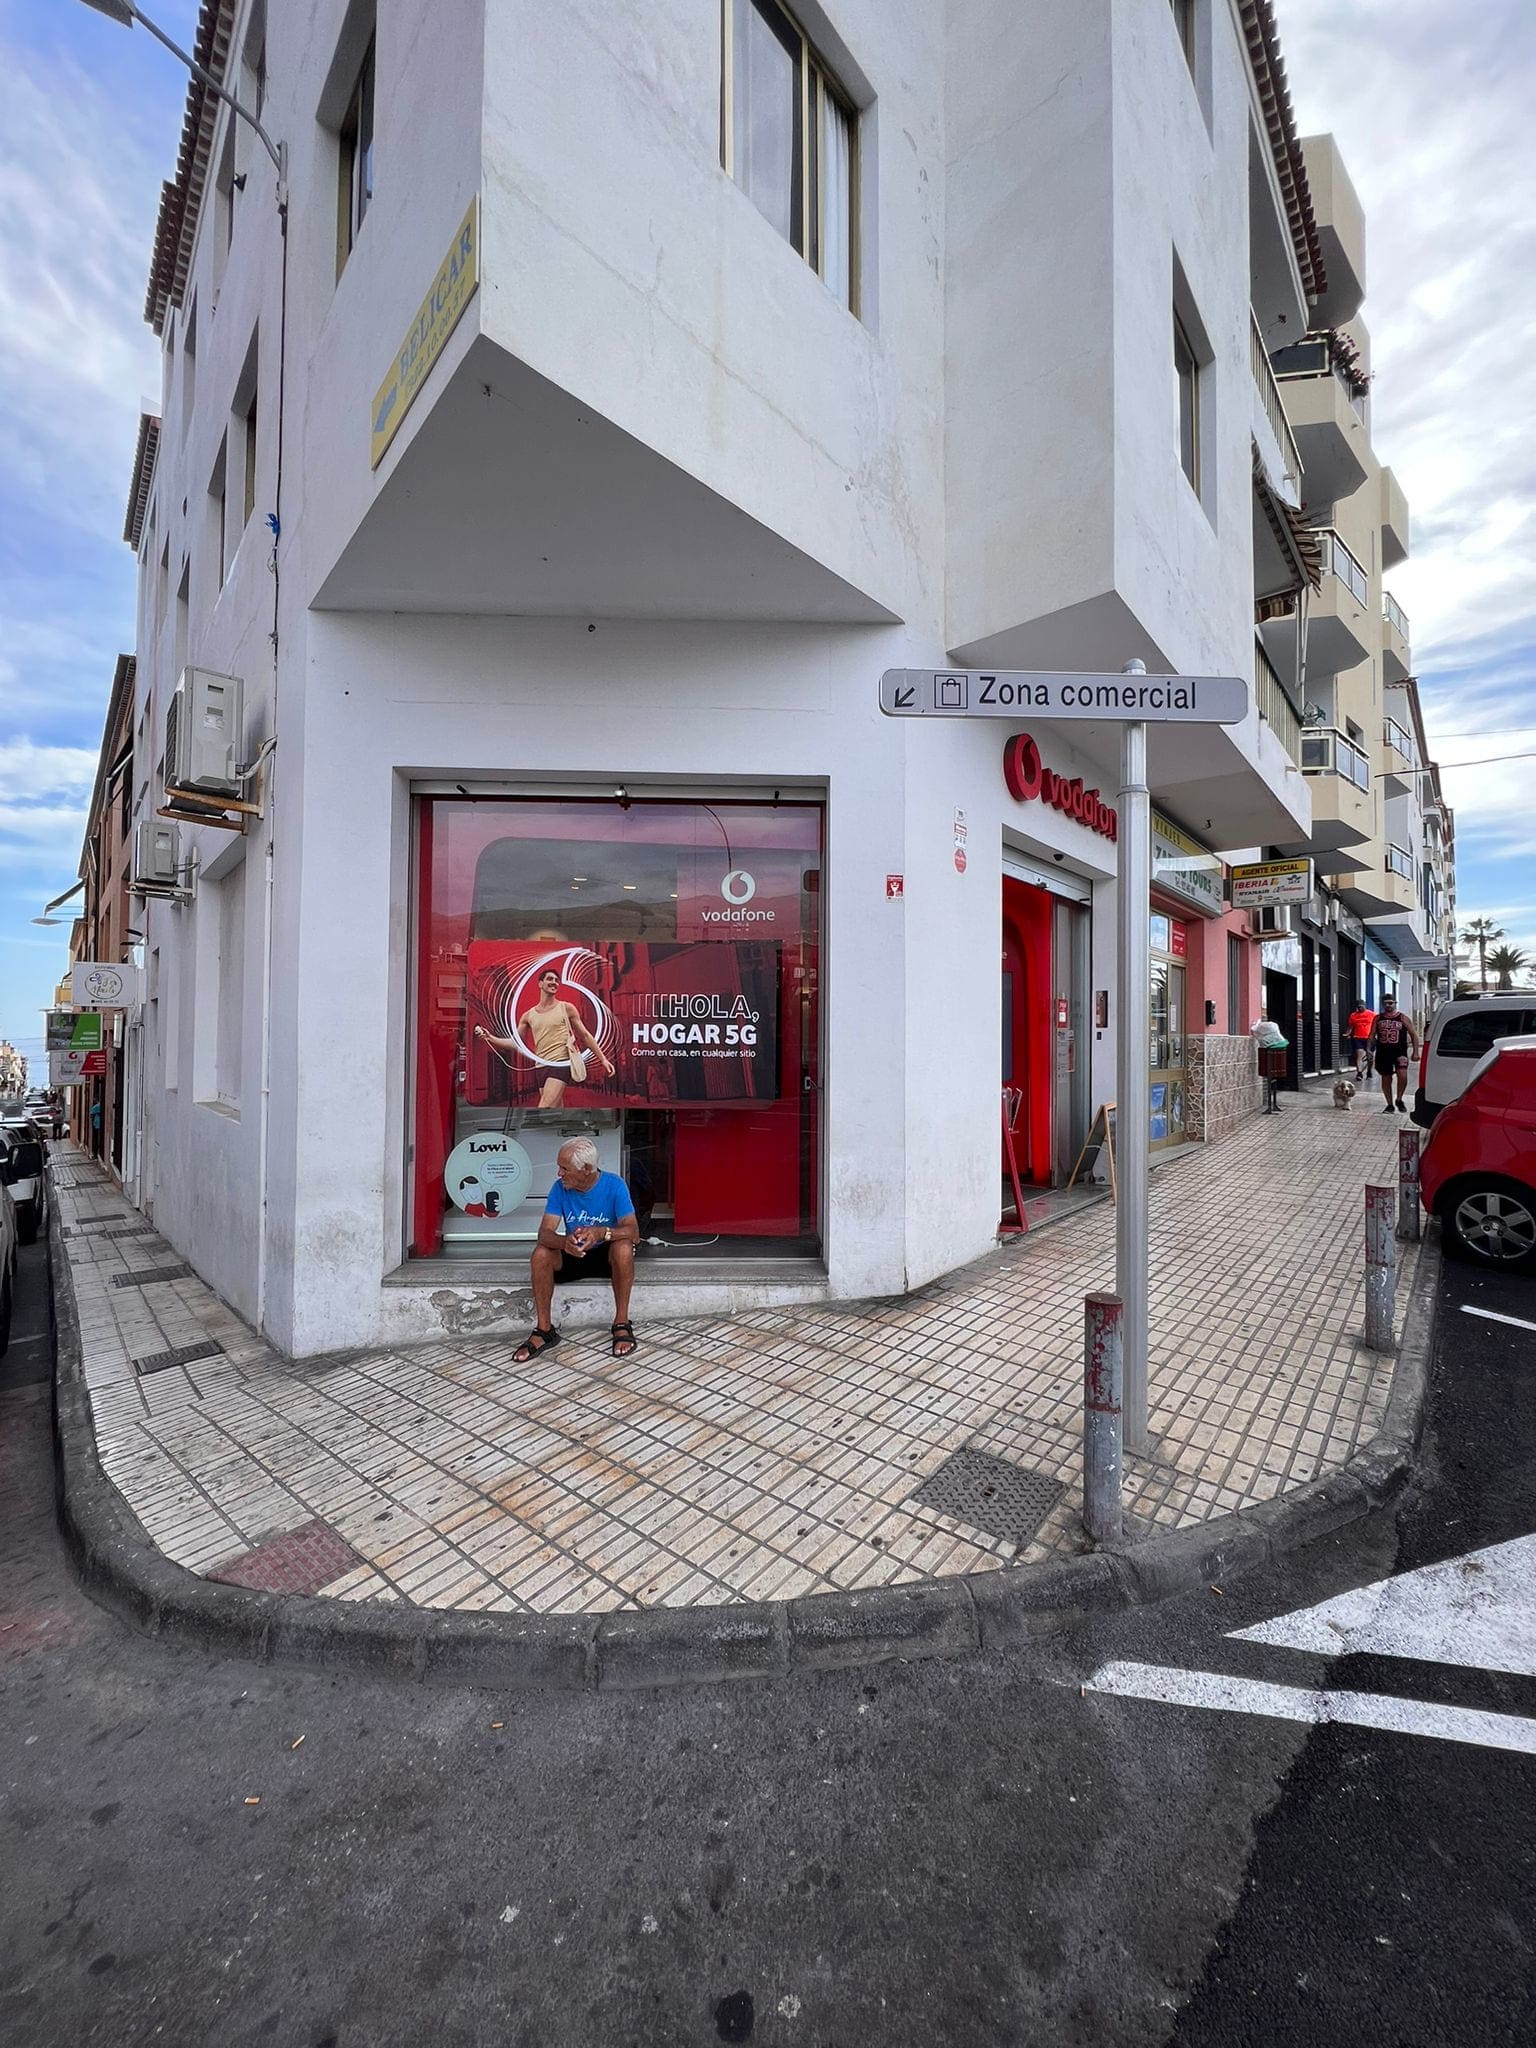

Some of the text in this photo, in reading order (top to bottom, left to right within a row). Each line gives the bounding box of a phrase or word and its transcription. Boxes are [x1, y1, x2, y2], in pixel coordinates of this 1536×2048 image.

[399, 222, 473, 383] BELICAR
[978, 676, 1197, 709] Zona comercial
[1041, 767, 1118, 843] vodafon
[1241, 863, 1299, 876] AGENTE OFICIAL
[1234, 878, 1269, 889] IBERIA
[701, 907, 776, 922] vodafone
[669, 993, 760, 1023] HOLA,
[632, 1023, 757, 1045] HOGAR 5G
[631, 1047, 656, 1057] Como
[657, 1049, 668, 1057] en
[669, 1049, 689, 1058] casa,
[702, 1049, 738, 1059] cualquier
[739, 1050, 756, 1058] sitio
[468, 1140, 508, 1153] Lowi
